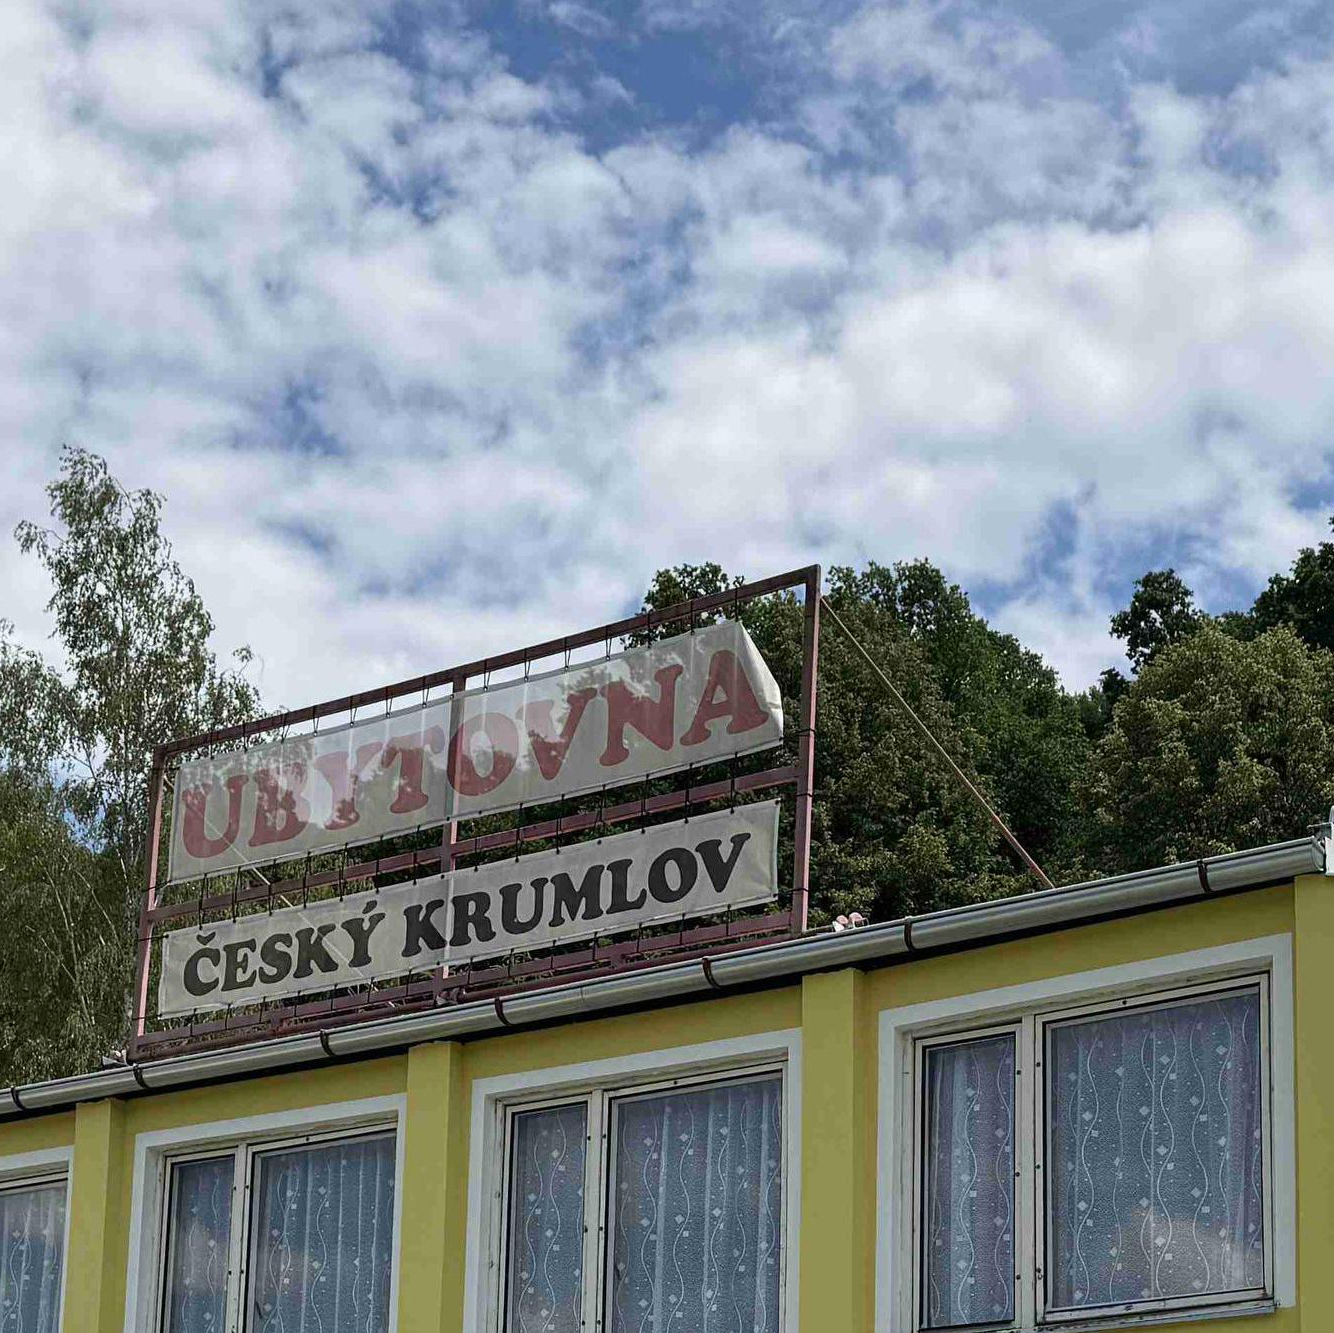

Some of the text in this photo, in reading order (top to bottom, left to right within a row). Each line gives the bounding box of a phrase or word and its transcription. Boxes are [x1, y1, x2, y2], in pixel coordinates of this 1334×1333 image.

[181, 649, 770, 859] UBYTOVNA
[183, 832, 751, 997] ČESKÝ KRUMLOV
